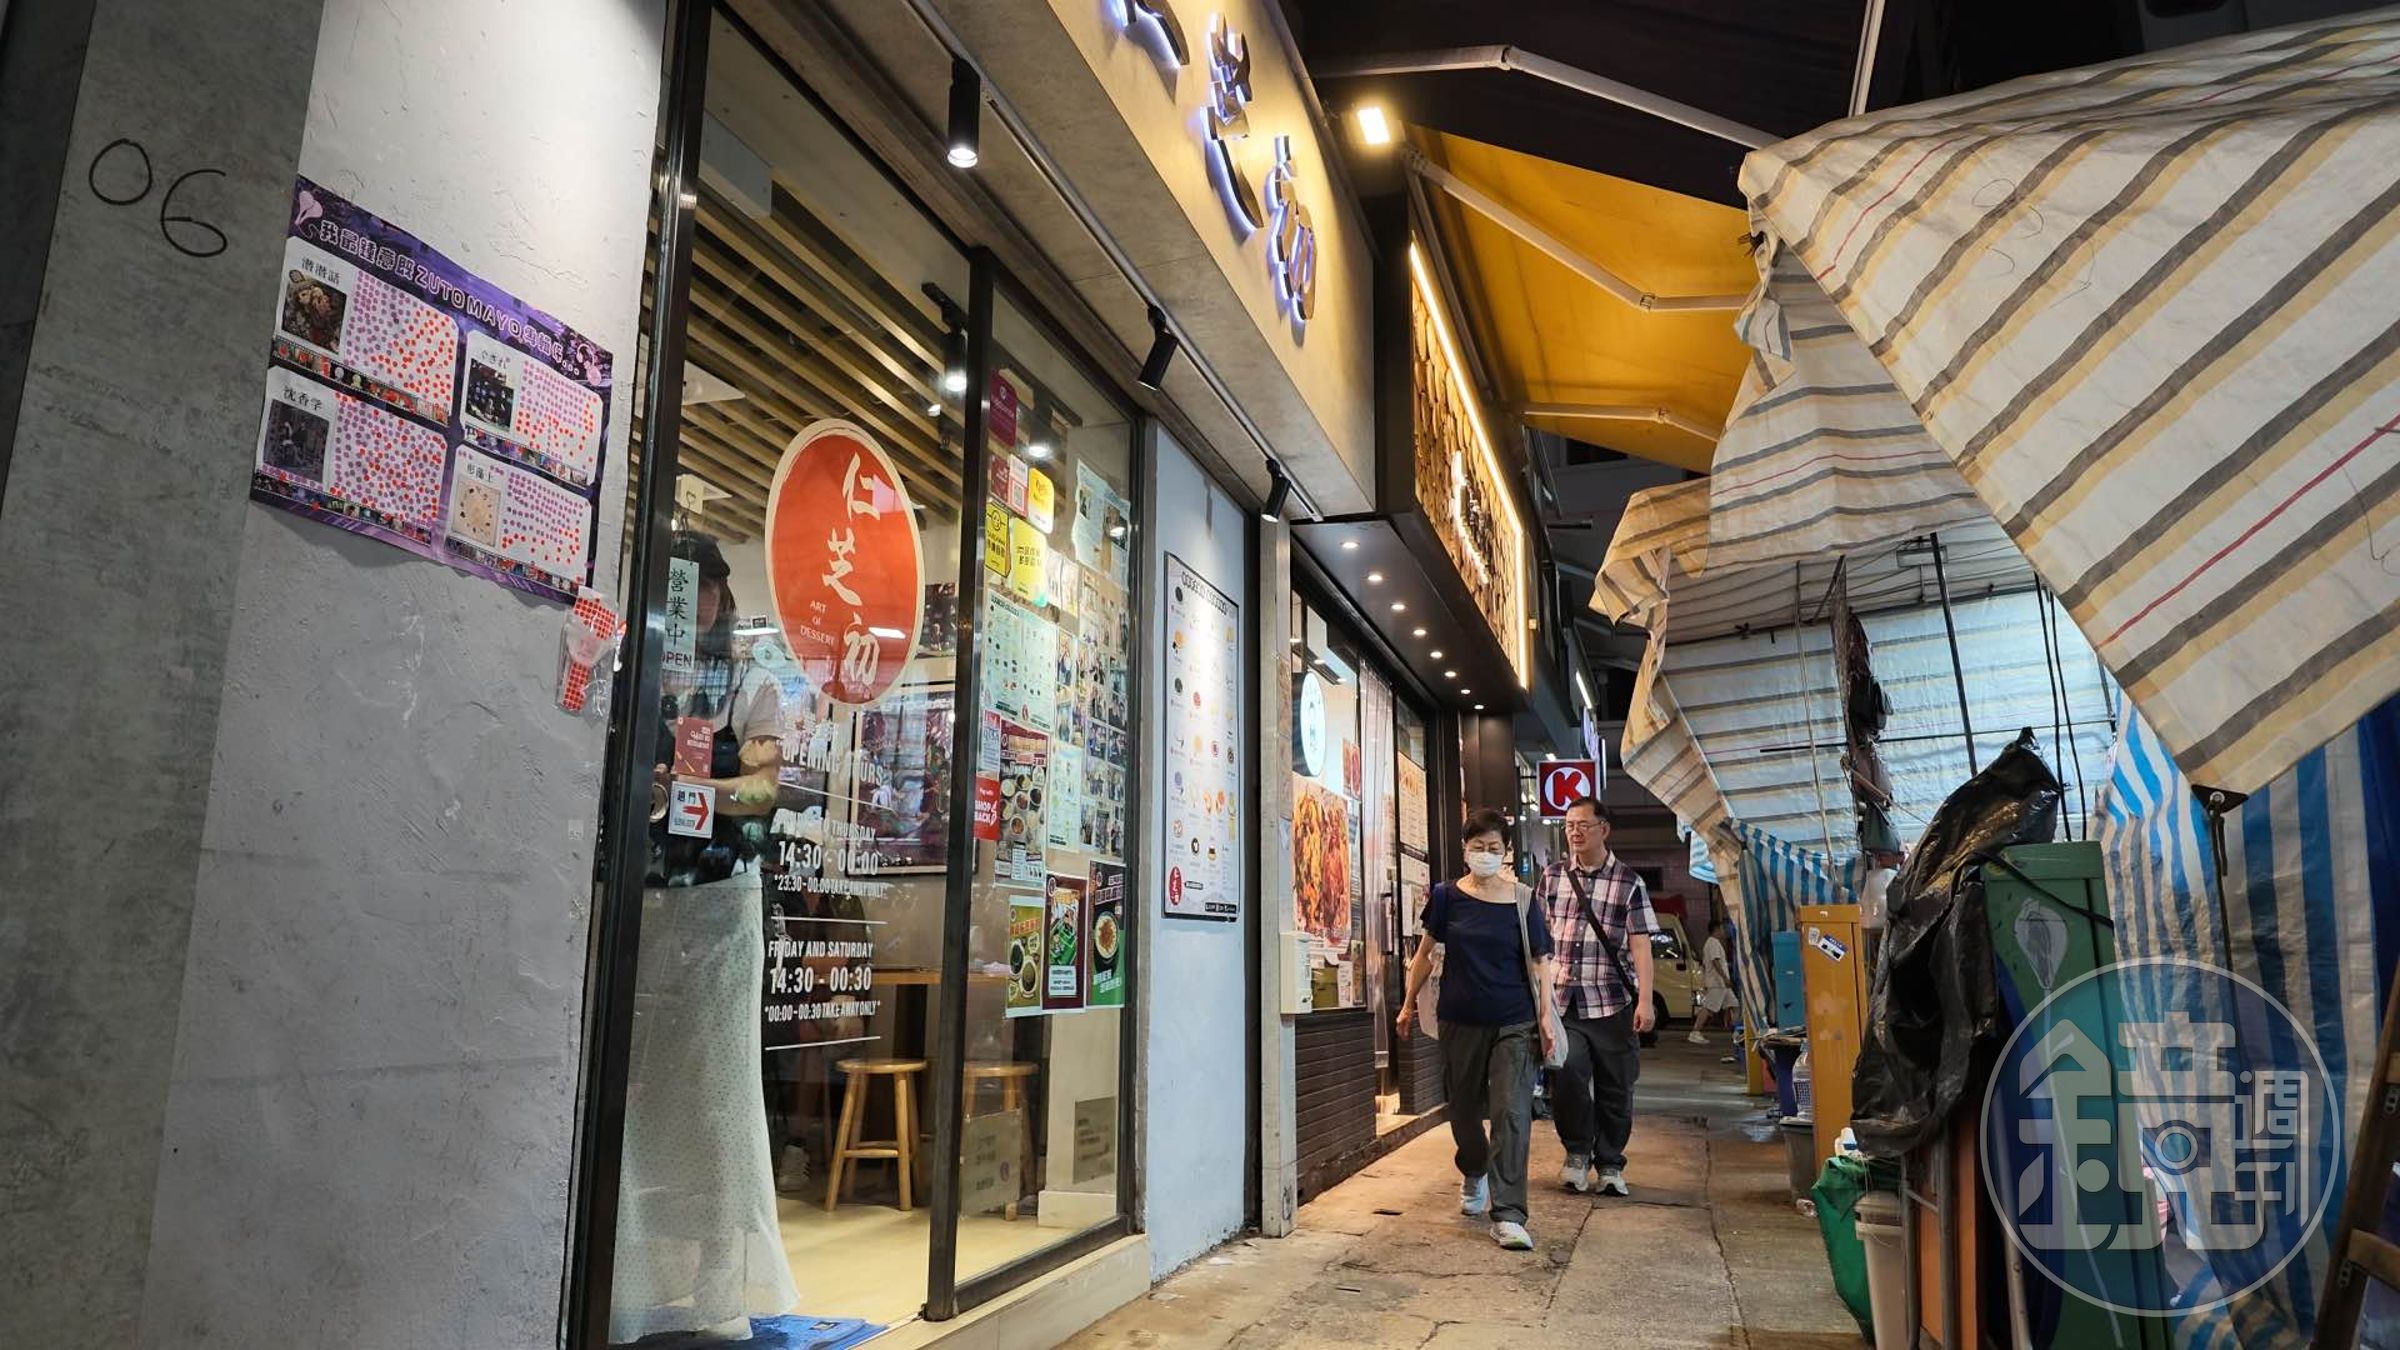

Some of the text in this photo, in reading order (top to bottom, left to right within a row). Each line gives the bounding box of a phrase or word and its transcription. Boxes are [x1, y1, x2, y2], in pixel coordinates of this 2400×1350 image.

[89, 138, 227, 258] 06
[666, 567, 689, 647] 營業中
[810, 600, 827, 615] ART
[800, 624, 835, 647] DESSERT
[1552, 771, 1582, 806] K
[779, 840, 822, 869] 14:30
[806, 941, 826, 958] AND
[828, 942, 874, 958] SATURDAY
[769, 967, 815, 995] 14:30
[830, 966, 872, 992] 00:30
